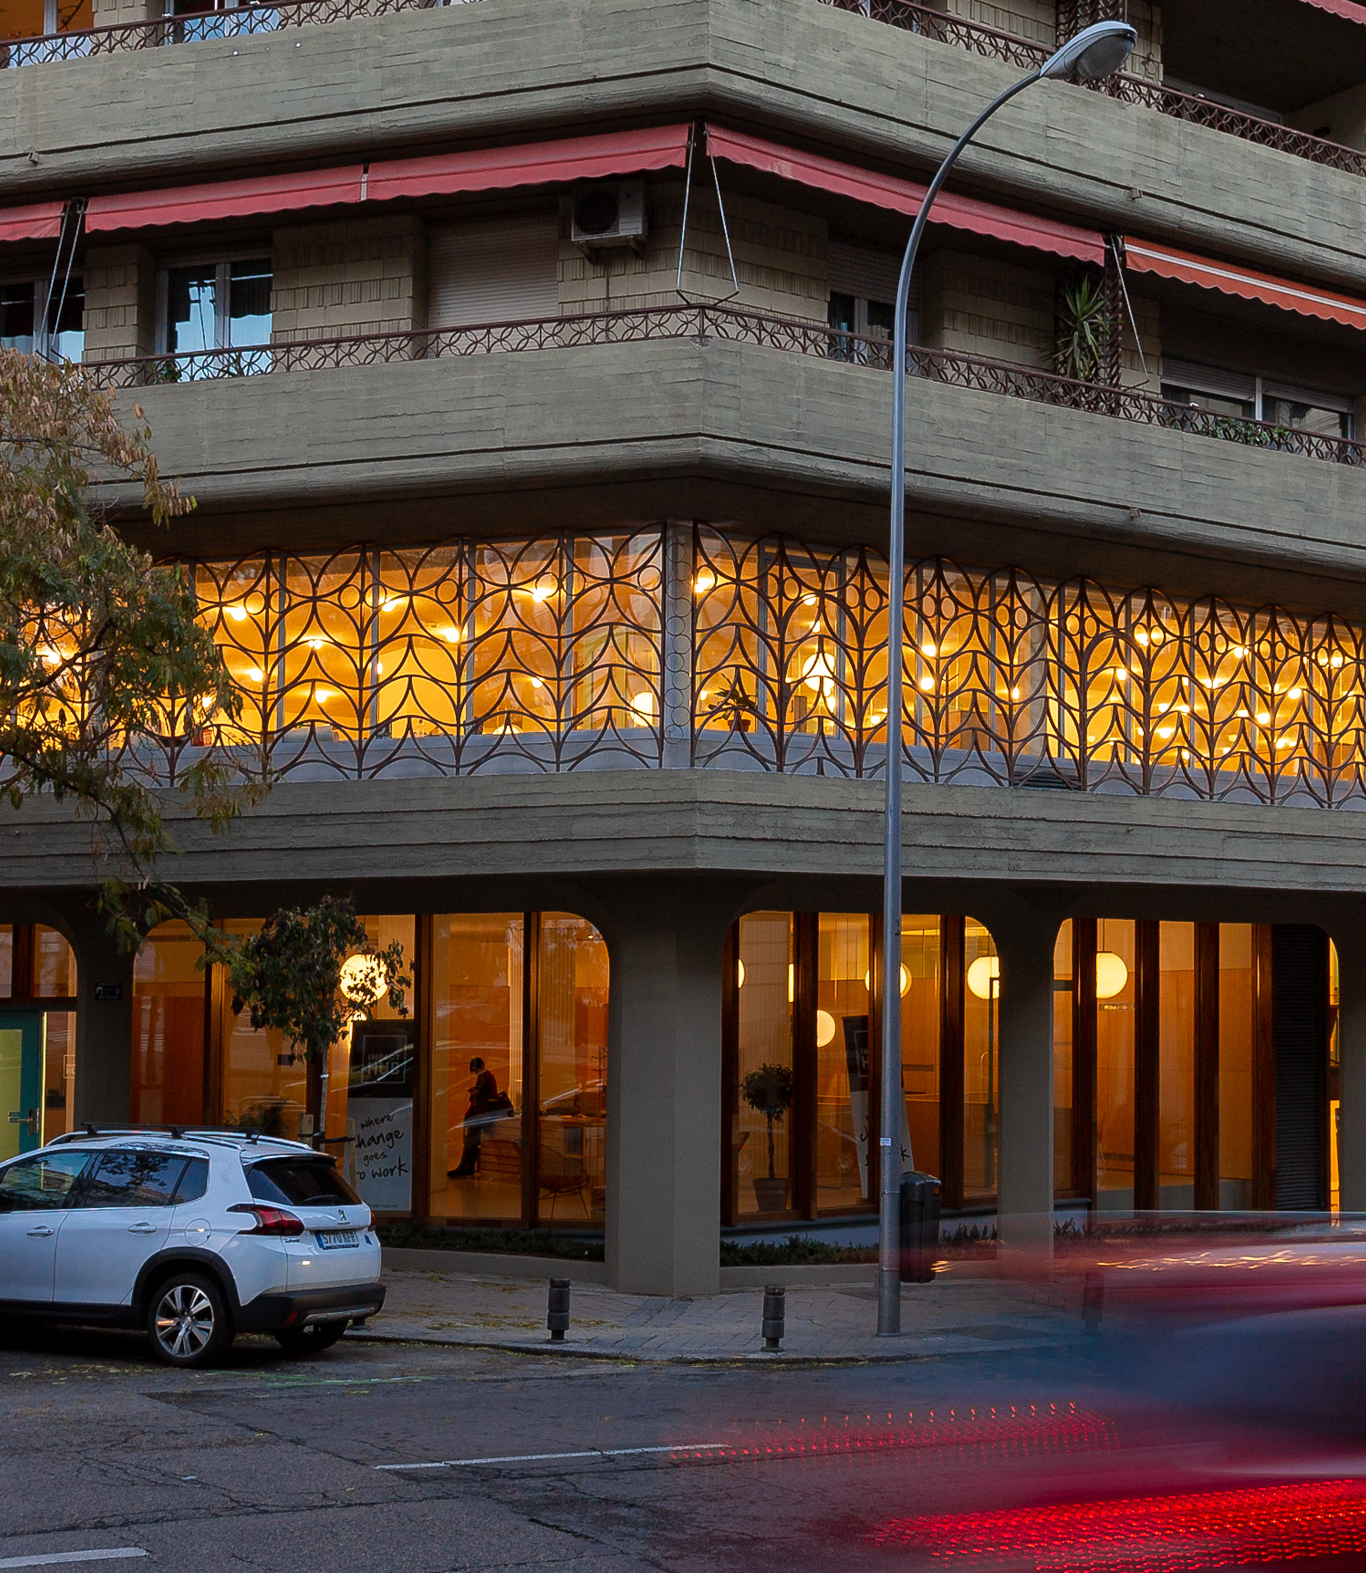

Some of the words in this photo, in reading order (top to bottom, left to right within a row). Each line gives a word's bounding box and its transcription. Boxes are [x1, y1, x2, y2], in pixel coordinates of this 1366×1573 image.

[360, 1113, 395, 1130] where
[355, 1127, 406, 1150] hange
[362, 1149, 389, 1166] goes
[372, 1156, 410, 1179] work
